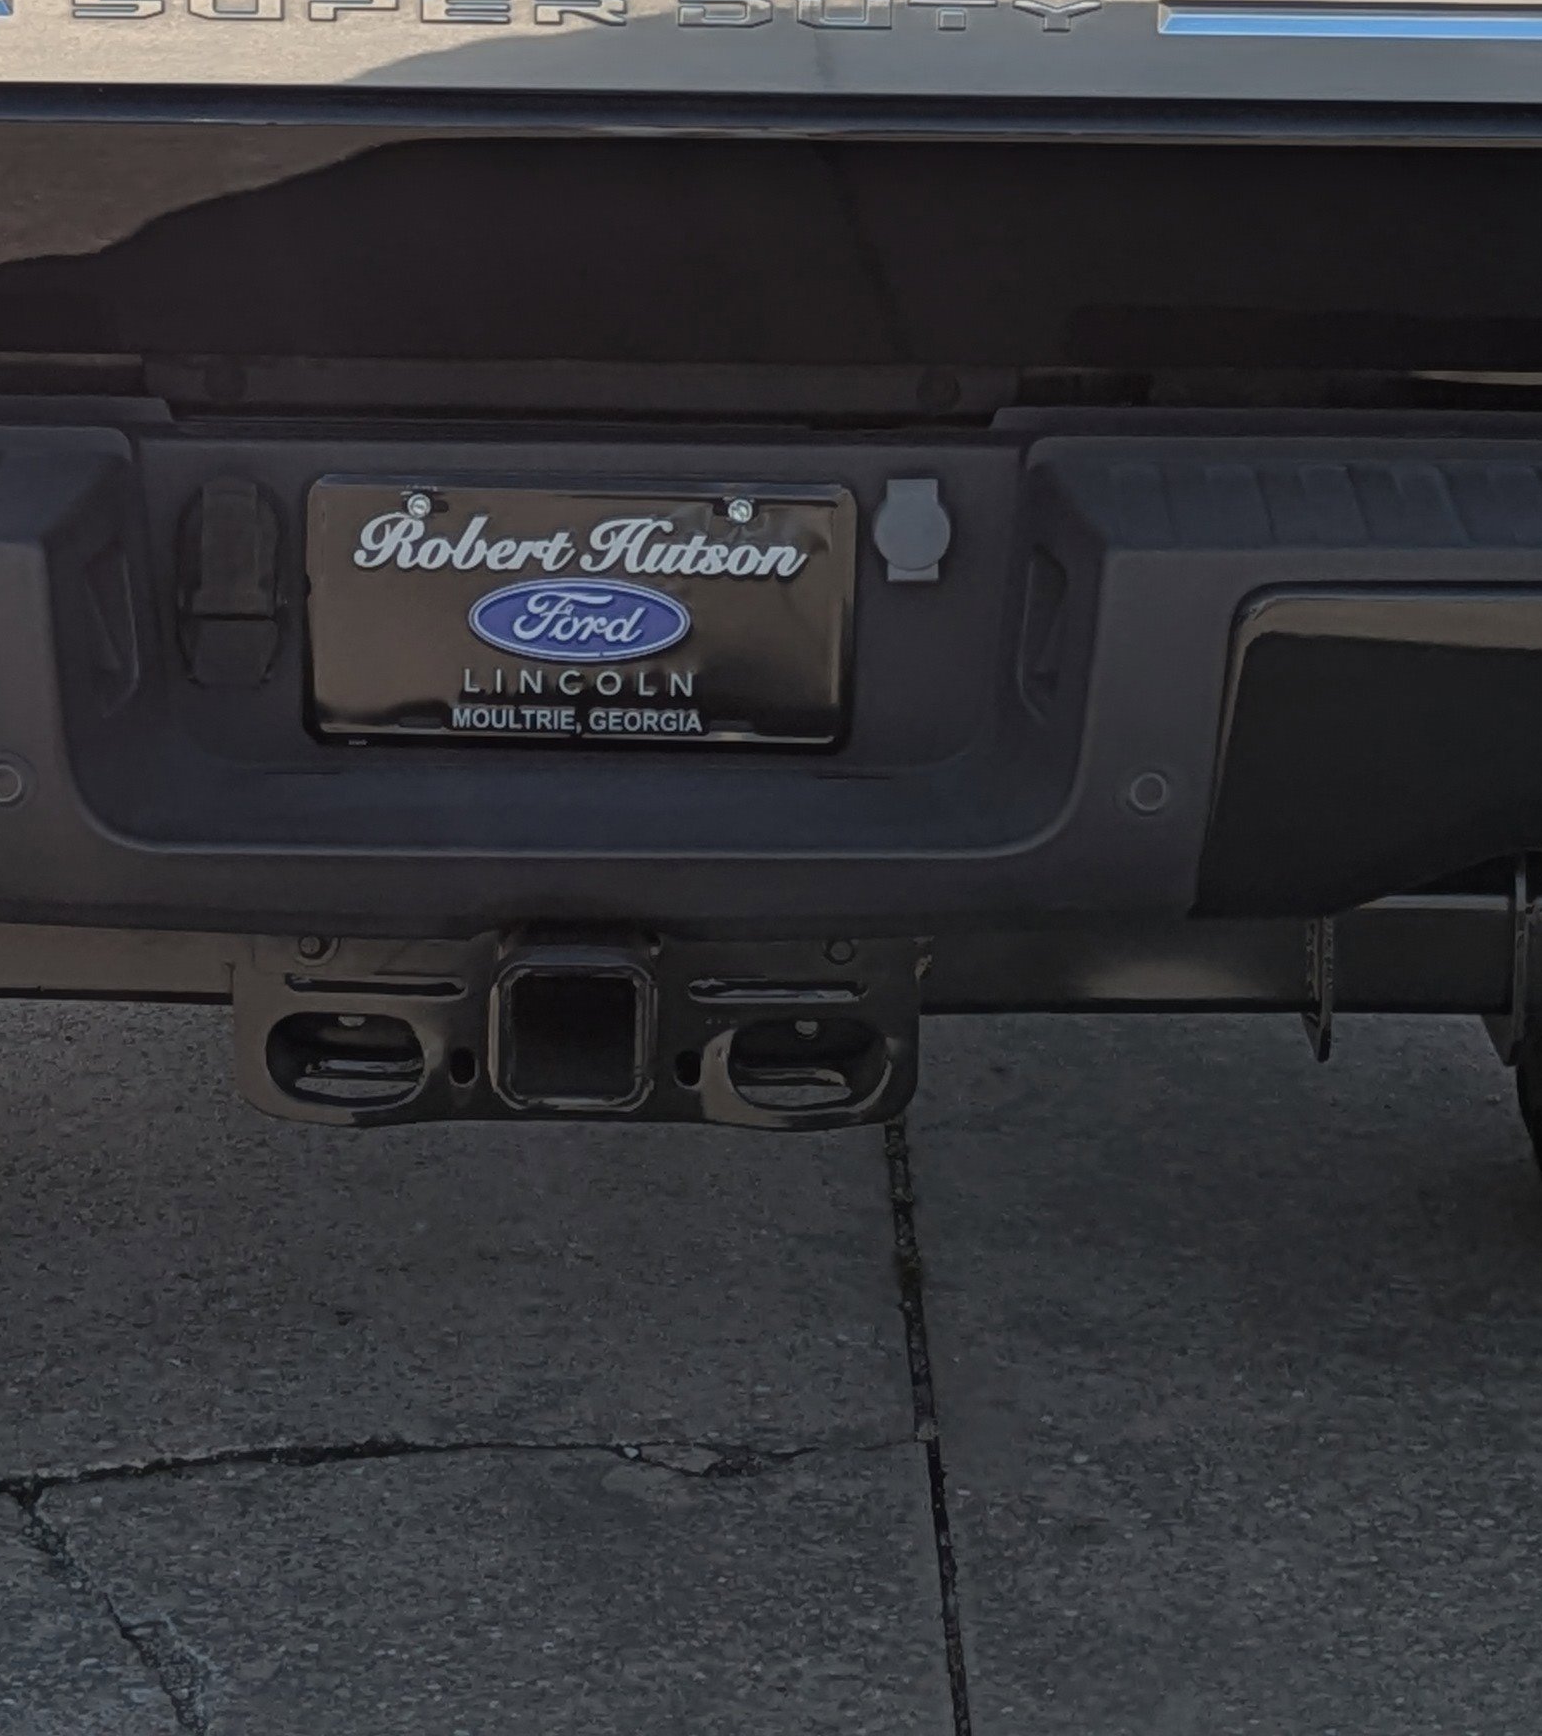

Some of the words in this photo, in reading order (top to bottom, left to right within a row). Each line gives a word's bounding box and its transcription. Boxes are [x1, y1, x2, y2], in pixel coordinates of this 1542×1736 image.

[353, 511, 580, 572] Robert
[579, 517, 809, 579] Hutson
[512, 590, 647, 644] Ford
[463, 669, 694, 698] LINCOLN
[452, 708, 583, 734] MOULTRIE,
[589, 708, 703, 734] GEORGIA
